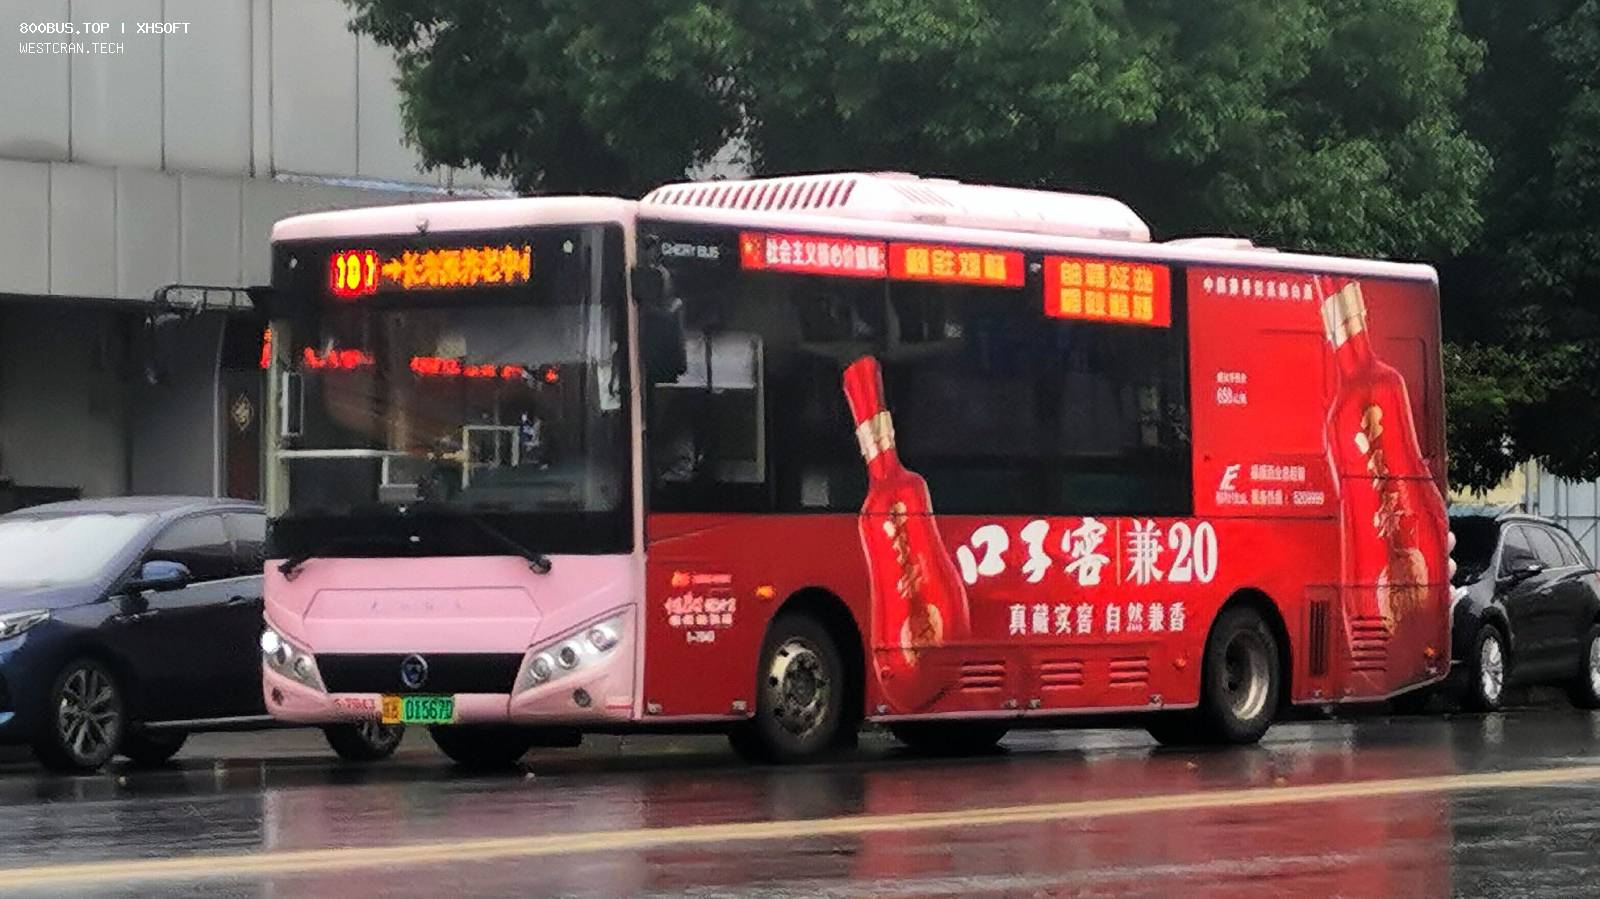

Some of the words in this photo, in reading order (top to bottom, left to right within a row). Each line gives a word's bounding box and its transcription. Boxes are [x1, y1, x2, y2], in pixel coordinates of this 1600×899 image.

[336, 253, 375, 290] 101
[1105, 601, 1186, 633] 自然兼香
